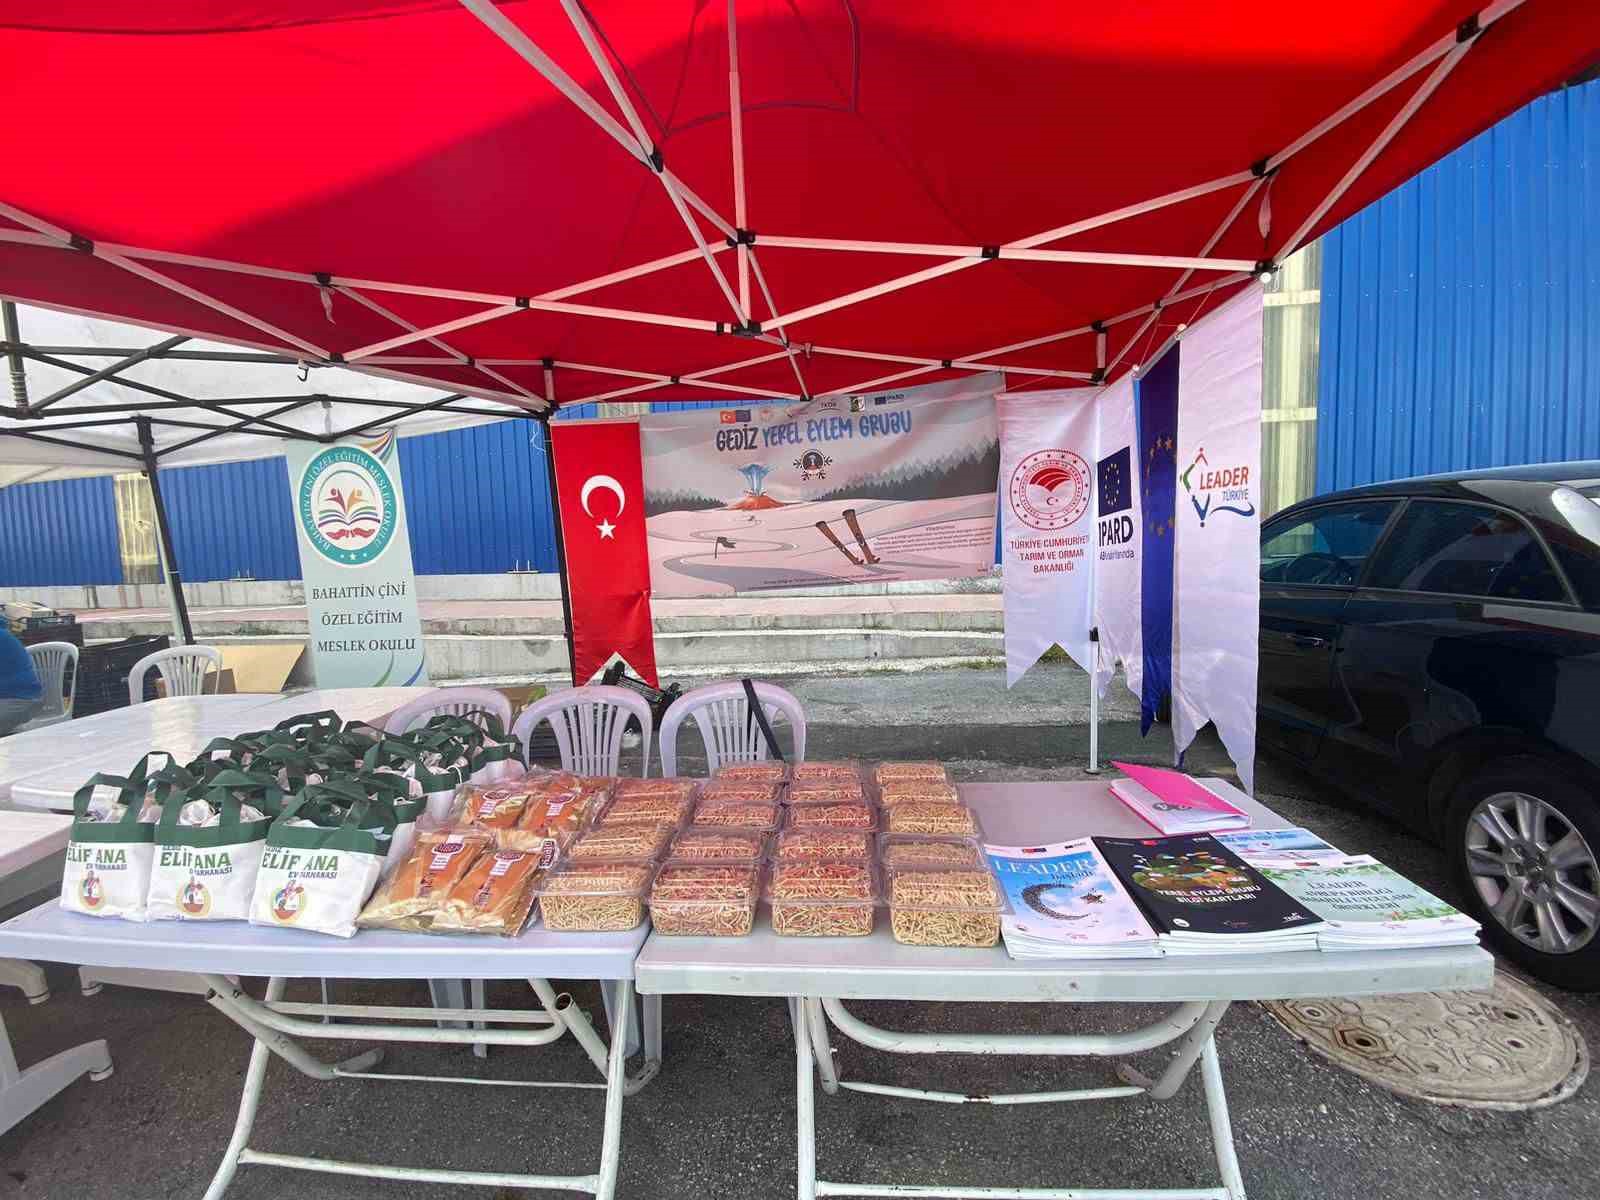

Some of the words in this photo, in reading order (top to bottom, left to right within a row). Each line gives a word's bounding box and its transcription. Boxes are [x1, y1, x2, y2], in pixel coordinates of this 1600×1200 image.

[716, 424, 758, 452] GEDİZ
[762, 422, 802, 448] YEREL
[806, 415, 854, 442] EYLEM
[858, 410, 912, 437] GRUBU
[1200, 466, 1249, 490] LEADER
[1098, 515, 1134, 548] IPARD
[1010, 537, 1041, 550] TÜRKİYE
[1020, 551, 1045, 560] TARIM
[1047, 551, 1056, 560] VE
[1033, 561, 1074, 574] BAKANLIĞI
[312, 583, 375, 599] BAHATTİN
[378, 580, 406, 600] ÇİNİ
[322, 611, 355, 626] ÖZEL
[357, 609, 403, 625] EĞİTİM
[318, 640, 366, 652] MESLEK
[368, 638, 416, 651] OKULU
[95, 848, 127, 864] ANA
[194, 851, 232, 870] ANA
[262, 850, 301, 871] ELİF
[303, 855, 339, 872] ANA
[994, 858, 1095, 876] LEADER
[1204, 893, 1256, 904] KARTLARI
